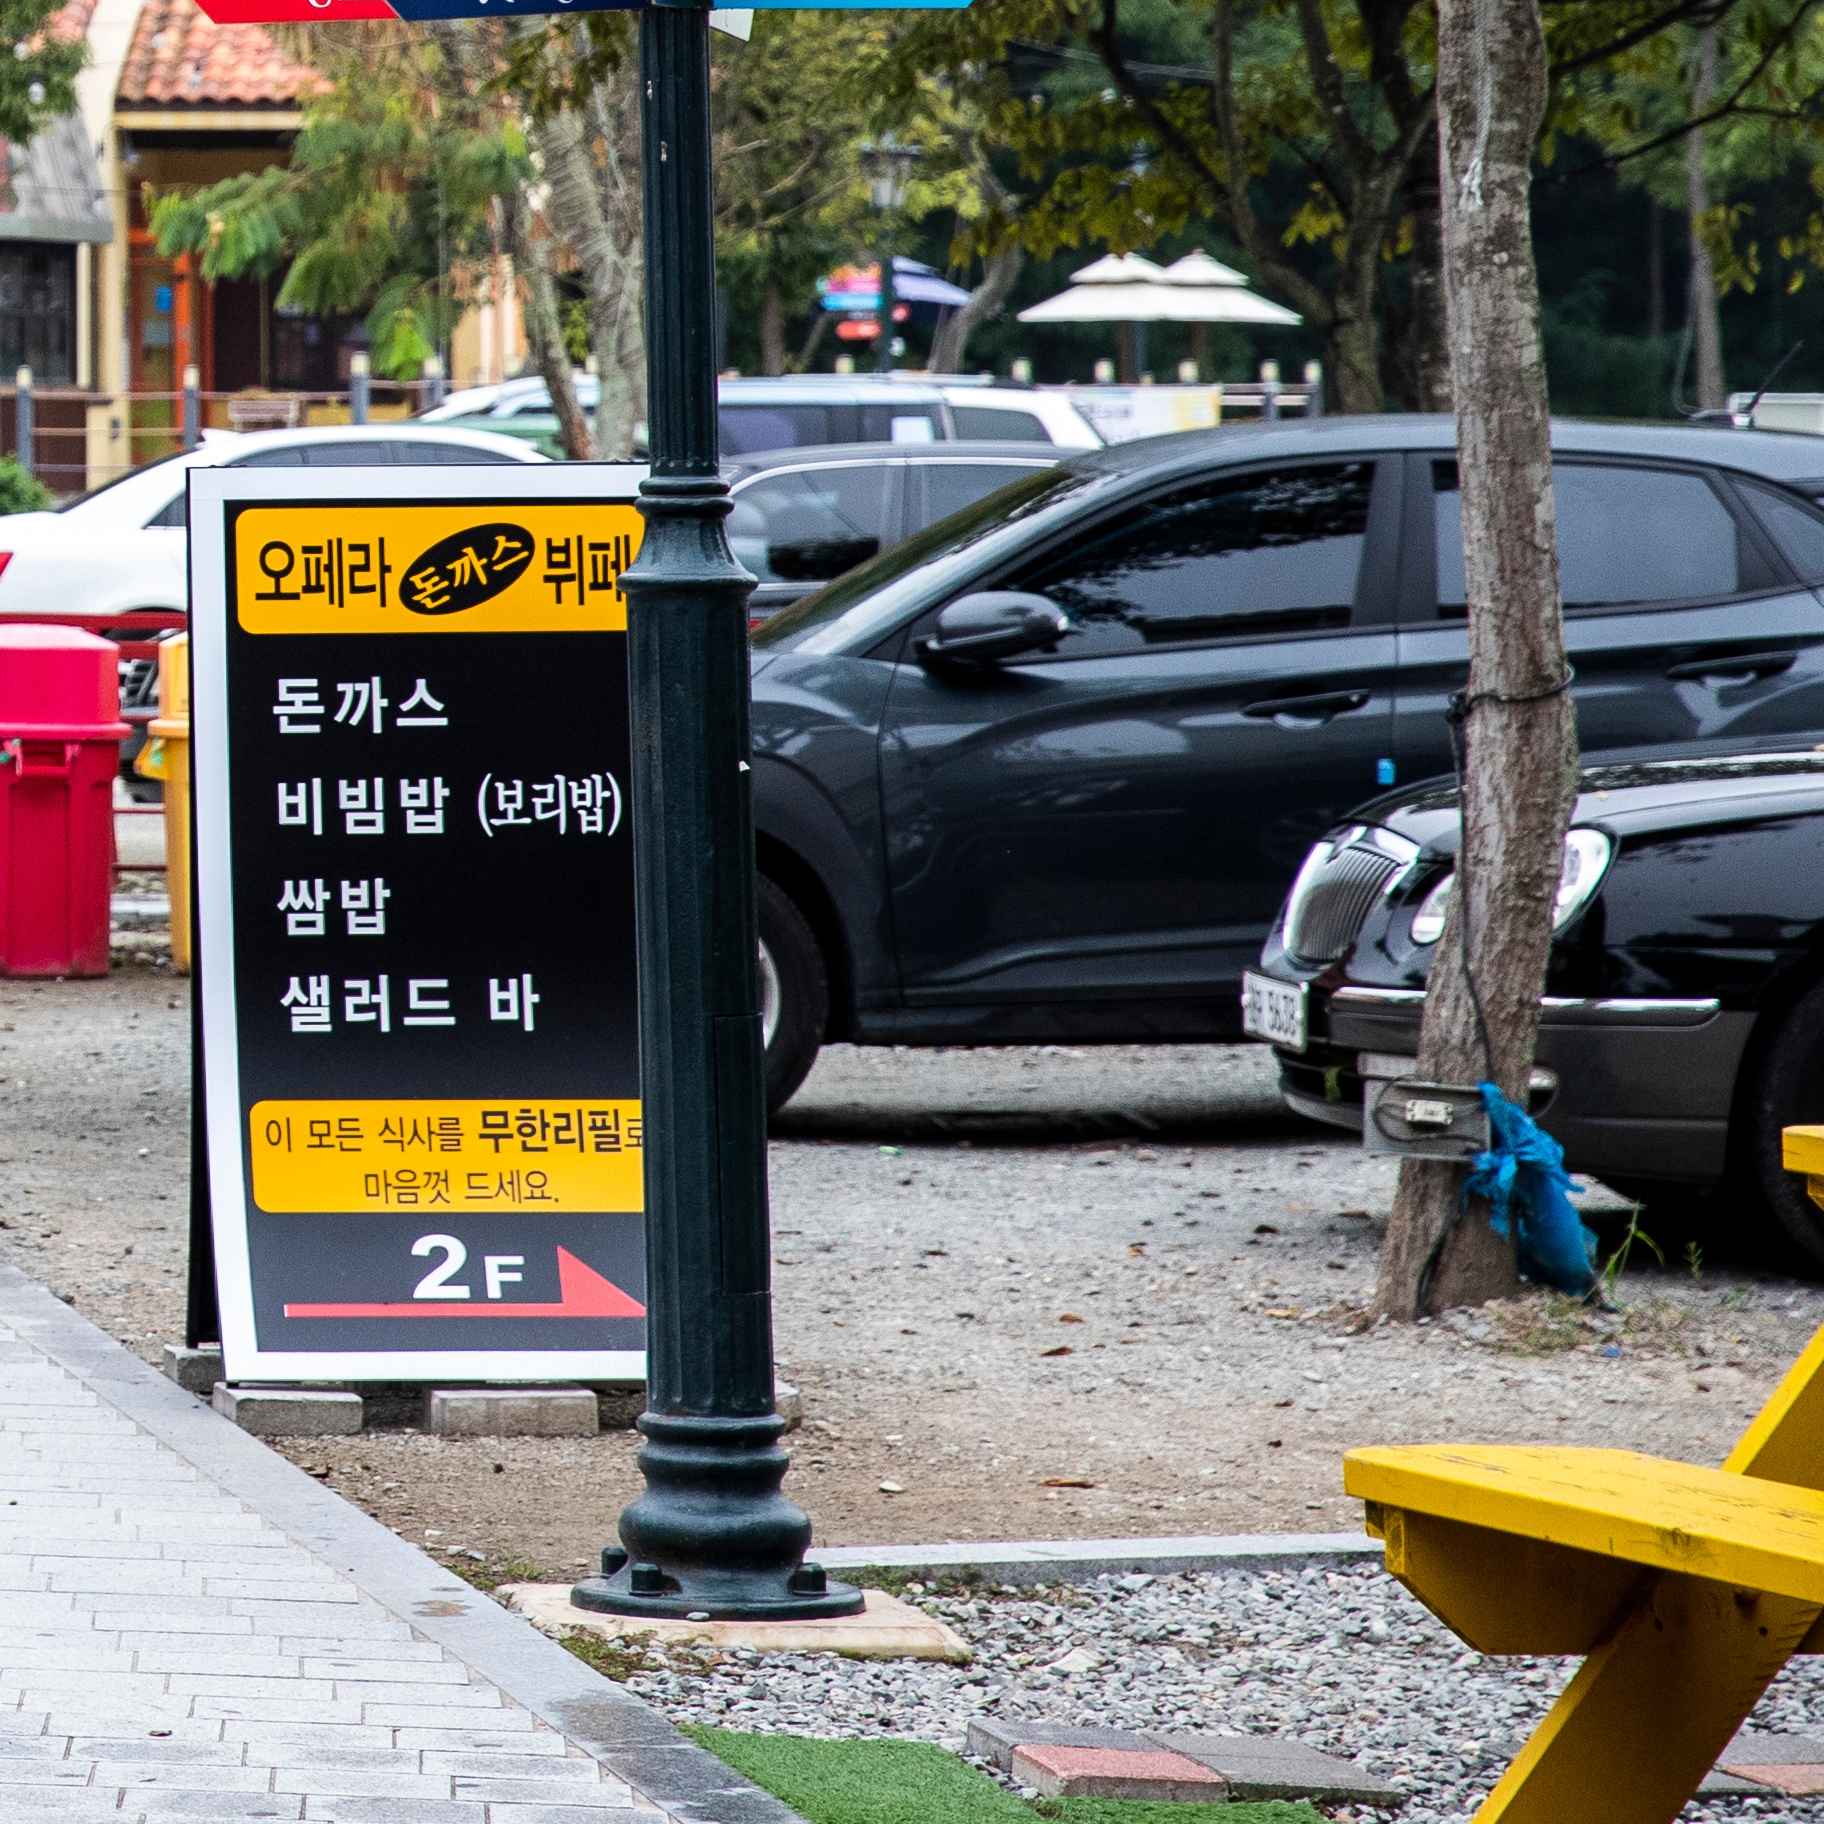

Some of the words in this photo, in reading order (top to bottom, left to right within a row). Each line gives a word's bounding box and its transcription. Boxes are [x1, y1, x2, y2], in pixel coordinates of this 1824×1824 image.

[254, 535, 392, 609] 오페라
[408, 531, 530, 610] 돈까스
[543, 533, 633, 606] 뷔페
[273, 676, 450, 735] 돈까스
[277, 776, 451, 836] 비빔밥
[477, 772, 623, 838] (보리밥)
[277, 877, 392, 937] 쌈밥
[280, 974, 456, 1033] 샐러드
[489, 973, 541, 1033] 바
[265, 1116, 293, 1153] 이
[306, 1116, 362, 1153] 모든
[378, 1116, 465, 1153] 식사를
[364, 1169, 451, 1205] 마음껏
[465, 1169, 560, 1204] 드세요.
[410, 1233, 526, 1300] 2F
